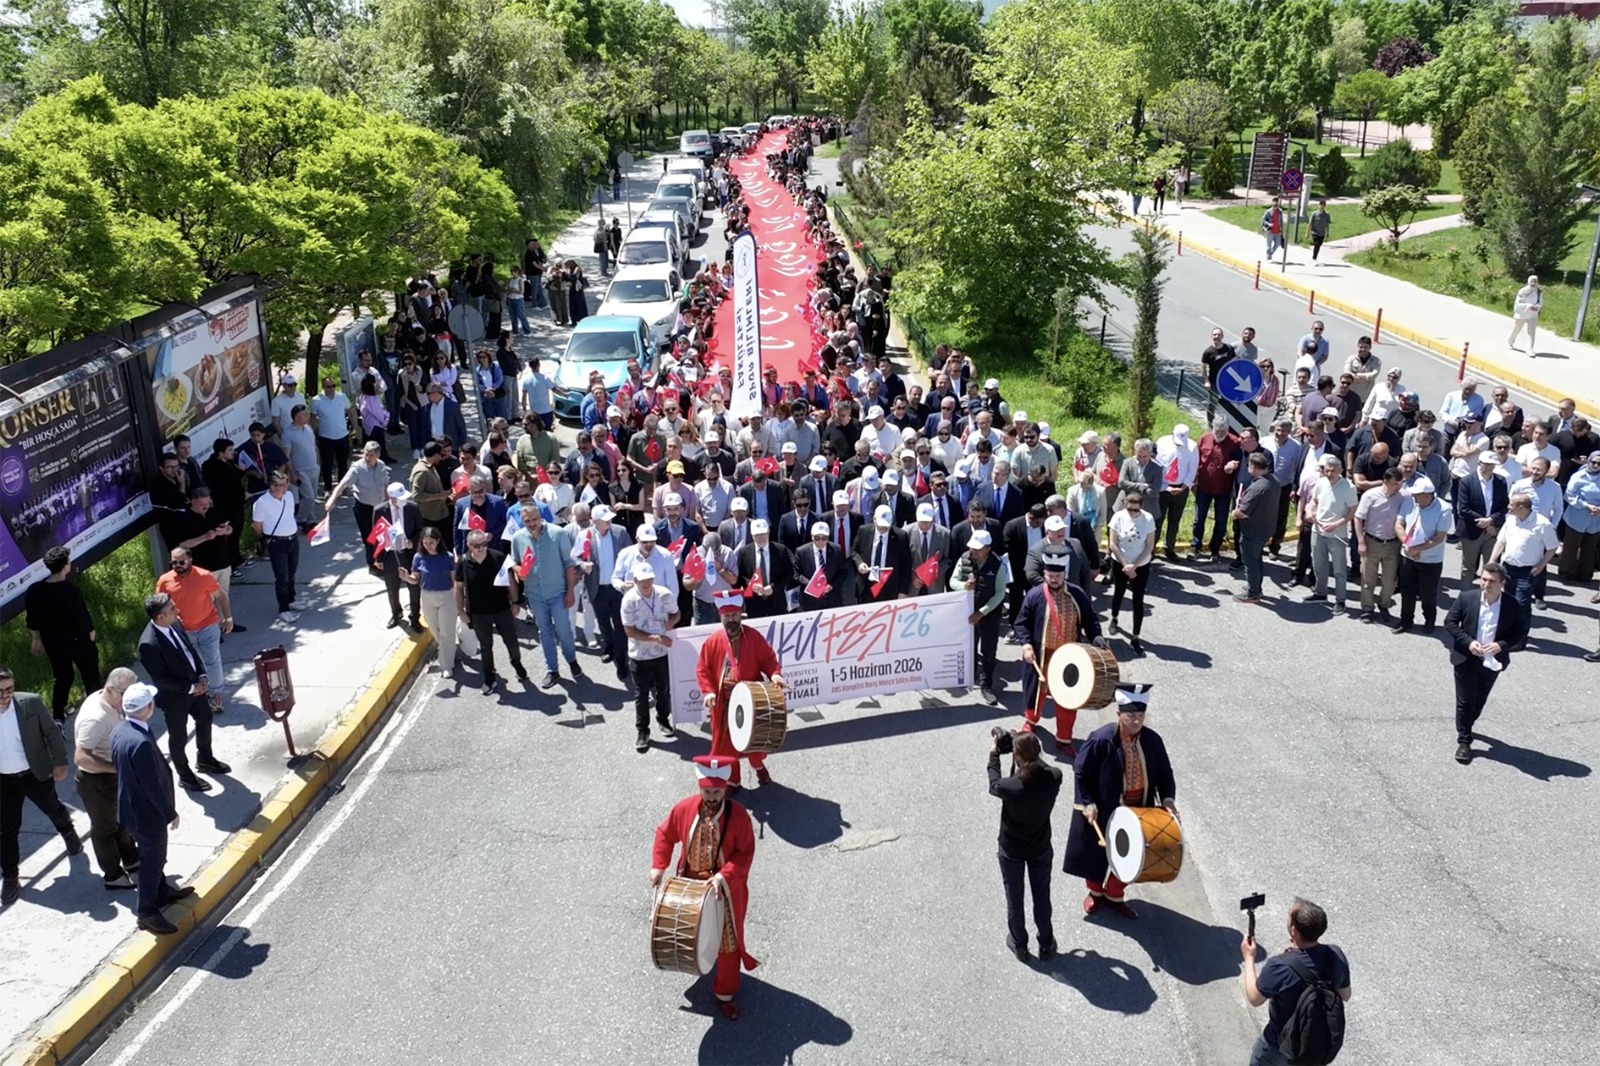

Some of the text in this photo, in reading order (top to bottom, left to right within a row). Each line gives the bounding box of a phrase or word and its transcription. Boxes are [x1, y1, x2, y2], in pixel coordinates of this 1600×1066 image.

[830, 667, 847, 683] 1-5
[849, 662, 892, 680] Haziran
[894, 657, 923, 674] 2026
[793, 676, 820, 688] SANAT
